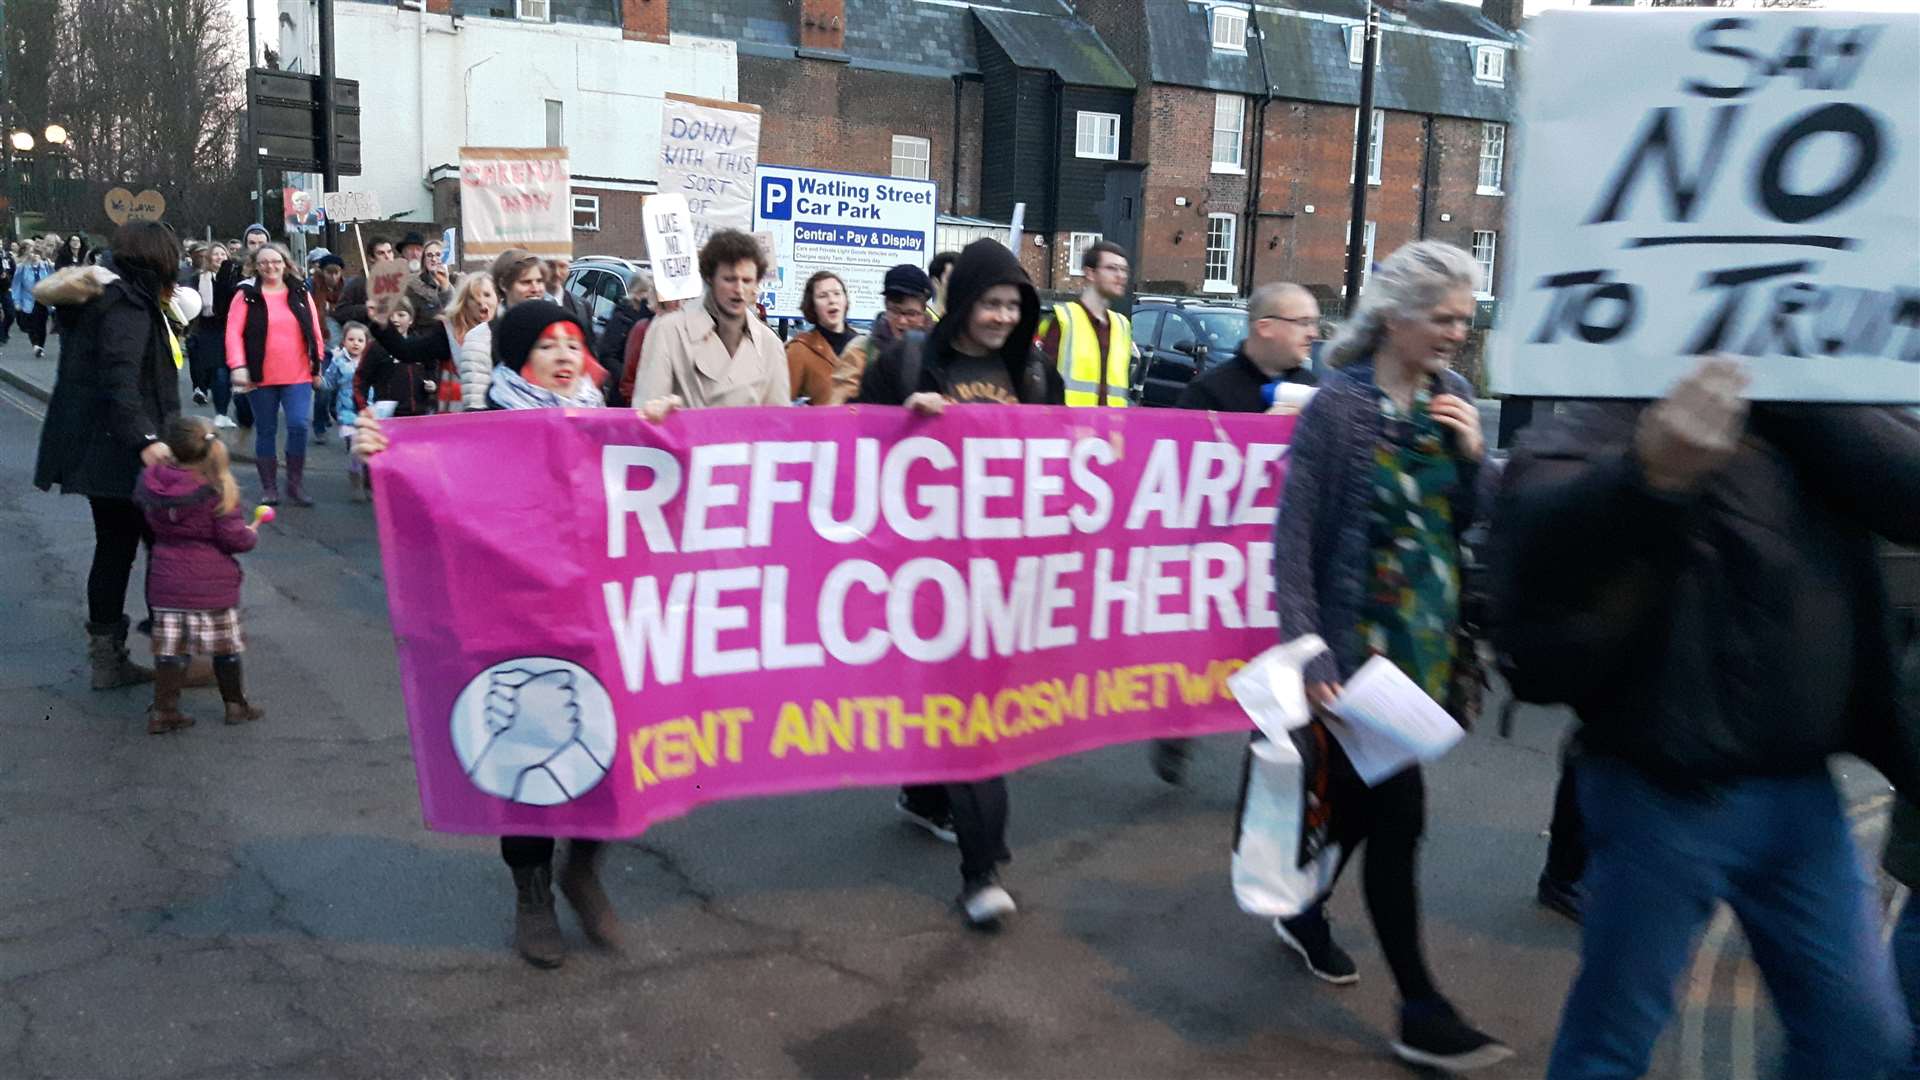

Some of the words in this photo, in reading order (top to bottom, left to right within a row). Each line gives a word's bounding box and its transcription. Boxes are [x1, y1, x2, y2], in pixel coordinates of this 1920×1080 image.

[1681, 17, 1888, 98] SAY
[670, 118, 738, 146] DOWN
[664, 145, 704, 165] WITH
[715, 152, 753, 175] THIS
[1583, 102, 1893, 224] NO
[683, 174, 732, 195] SORT
[766, 183, 787, 213] P
[798, 177, 869, 203] Watling
[876, 184, 932, 205] Street
[688, 199, 713, 215] OF
[797, 198, 831, 216] Car
[838, 201, 881, 220] Park
[655, 213, 681, 233] LIKE
[795, 227, 837, 242] Central
[847, 231, 868, 248] Pay
[870, 232, 879, 244] &
[882, 233, 922, 250] Display
[1531, 269, 1641, 344] TO
[602, 436, 1115, 558] REFUGEES
[1124, 439, 1290, 530] ARE
[602, 552, 1084, 692] WELCOME
[1090, 541, 1280, 640] HERE
[628, 707, 754, 792] KENT
[769, 673, 1089, 759] ANTI-RACISM
